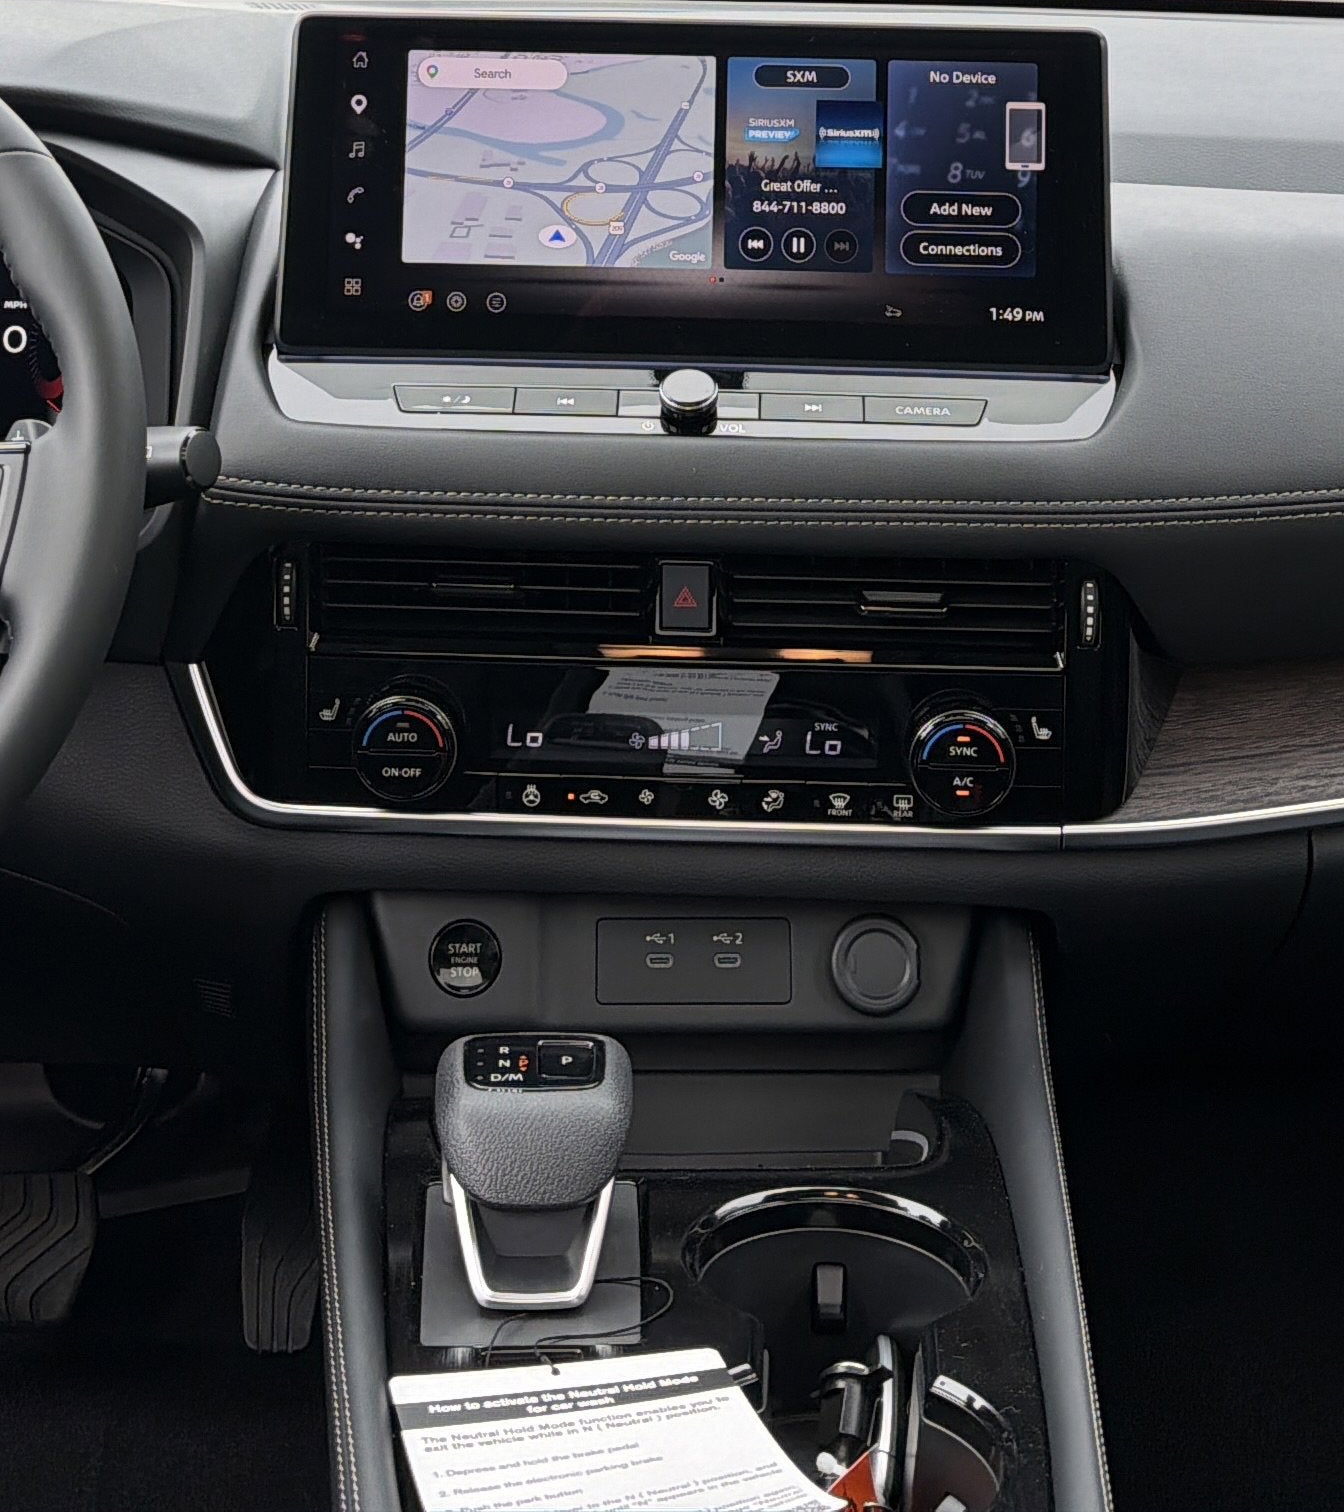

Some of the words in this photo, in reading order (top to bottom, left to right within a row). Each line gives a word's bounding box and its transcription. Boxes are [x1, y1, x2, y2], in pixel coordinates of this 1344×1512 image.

[473, 67, 513, 81] Search
[785, 69, 818, 83] SXM
[929, 70, 950, 84] No
[952, 70, 998, 85] Device
[946, 161, 964, 184] 8
[760, 179, 793, 193] Great
[793, 180, 822, 193] Offer
[752, 200, 847, 215] 844-711-8800
[929, 201, 959, 216] Add
[961, 203, 993, 217] New
[918, 241, 1003, 257] Connections
[668, 250, 706, 264] Google
[3, 300, 28, 310] MPH
[988, 306, 1024, 324] 1:49
[1024, 309, 1045, 324] PM
[894, 404, 952, 417] CAMERA
[719, 423, 747, 435] VOL
[813, 722, 839, 733] SYNC
[386, 732, 418, 743] AUTO
[948, 745, 979, 758] SYNC
[952, 775, 975, 788] A/C
[827, 808, 853, 817] FRONT
[668, 933, 675, 945] 1
[734, 932, 744, 945] 2
[447, 942, 482, 955] START
[450, 956, 479, 965] ENGINE
[449, 966, 480, 978] STOP
[498, 1045, 510, 1055] R
[498, 1058, 511, 1068] N
[561, 1056, 573, 1066] P
[489, 1072, 524, 1082] D/M
[427, 1404, 461, 1415] How
[463, 1400, 480, 1411] to
[482, 1393, 539, 1408] activate
[540, 1390, 565, 1402] the
[567, 1382, 620, 1398] Neutral
[622, 1378, 657, 1392] Hold
[658, 1374, 698, 1388] Mode
[525, 1404, 547, 1415] for
[550, 1402, 574, 1412] car
[576, 1395, 615, 1408] wash
